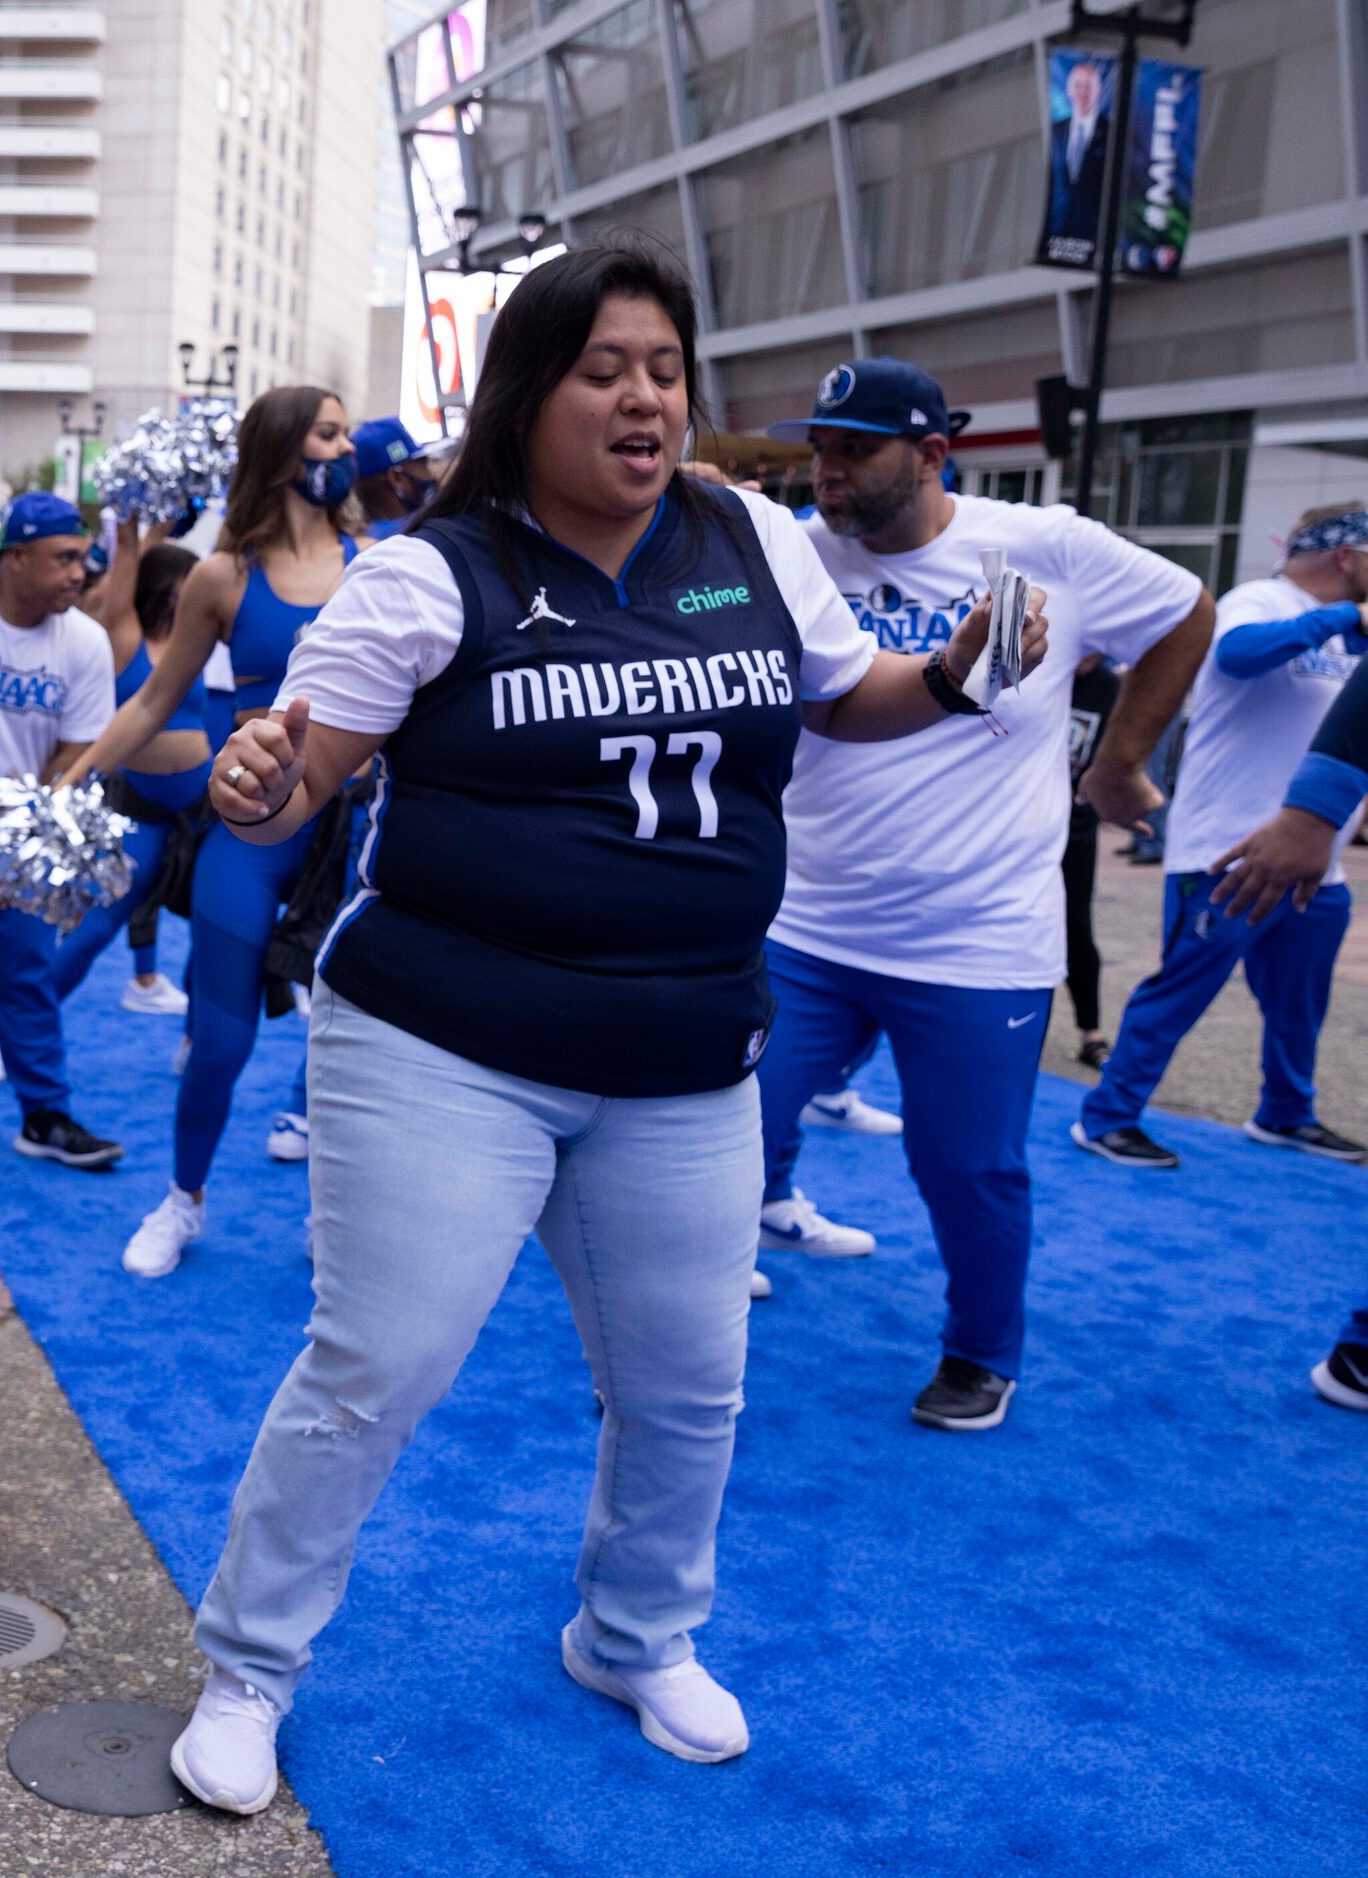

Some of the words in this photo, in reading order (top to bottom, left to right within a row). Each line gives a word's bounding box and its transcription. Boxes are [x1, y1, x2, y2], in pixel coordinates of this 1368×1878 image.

[677, 585, 750, 614] chime
[491, 649, 793, 731] MAVERICKS
[600, 731, 722, 839] 77
